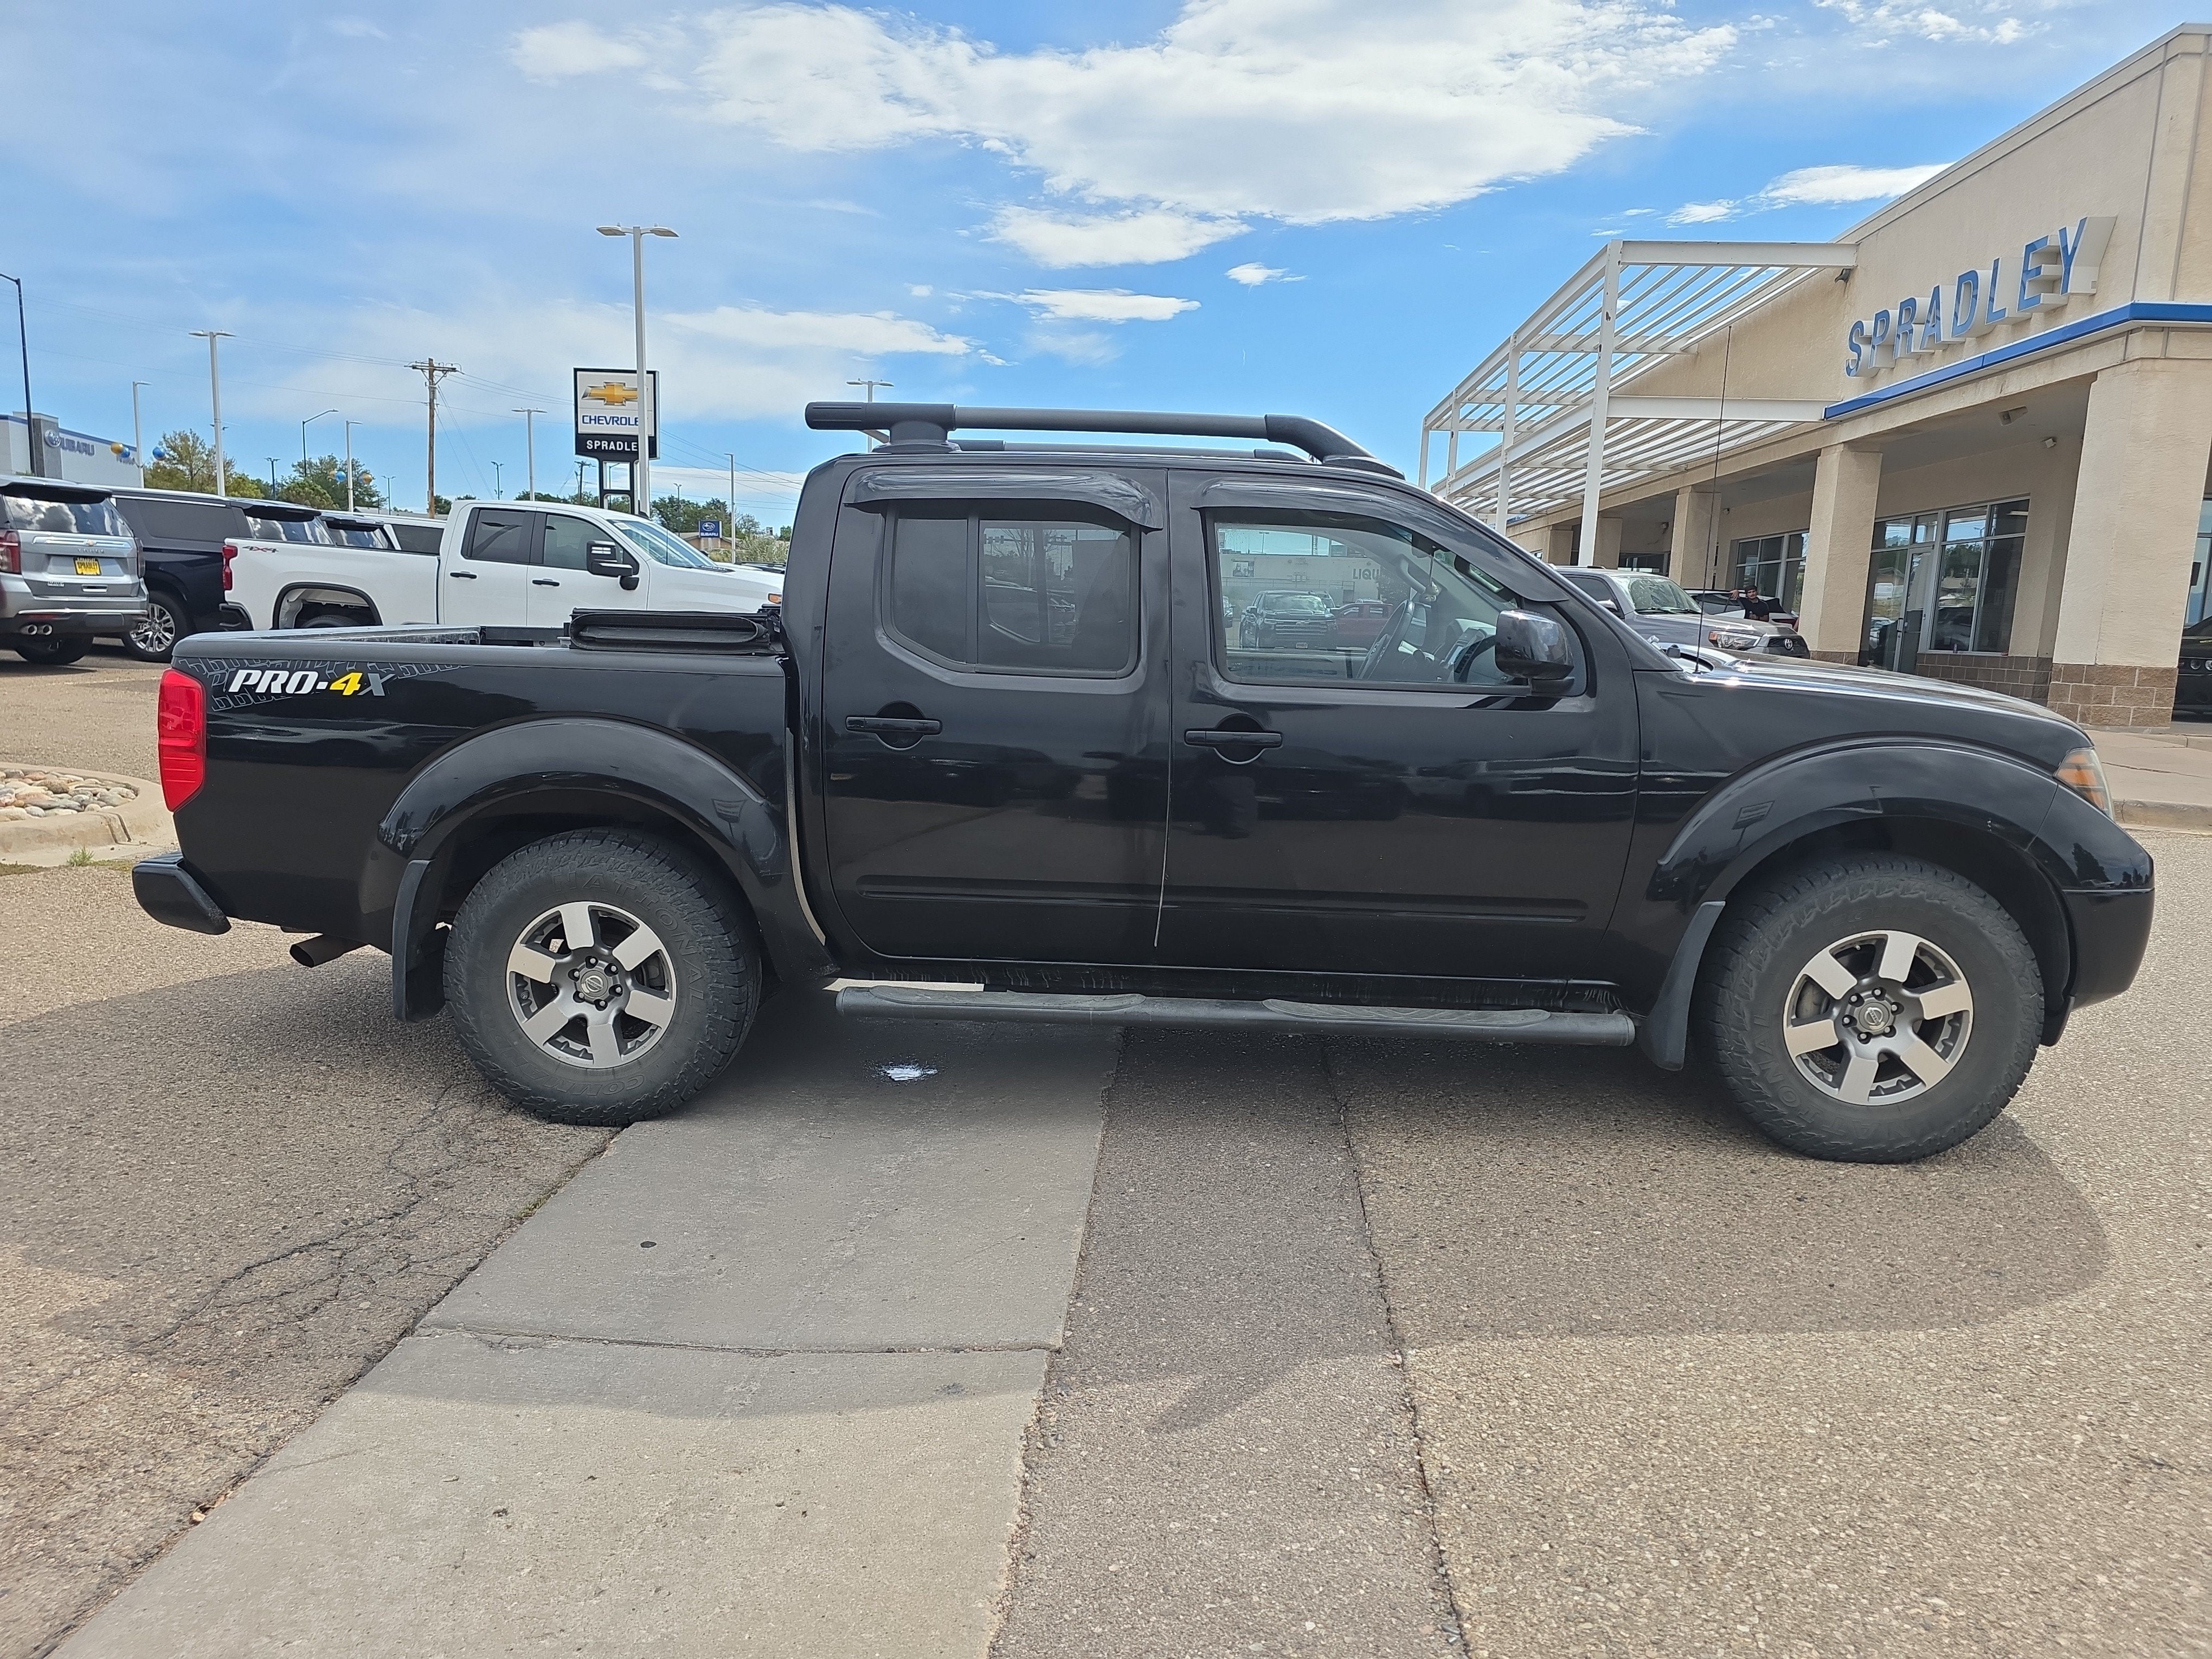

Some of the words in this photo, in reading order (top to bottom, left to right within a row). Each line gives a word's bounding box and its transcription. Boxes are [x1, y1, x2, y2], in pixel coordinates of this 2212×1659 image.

[1845, 216, 2089, 377] SPRADLEY
[582, 415, 639, 426] CHEVROLE
[586, 440, 638, 451] SPRADLE
[228, 670, 397, 697] PRO-4X
